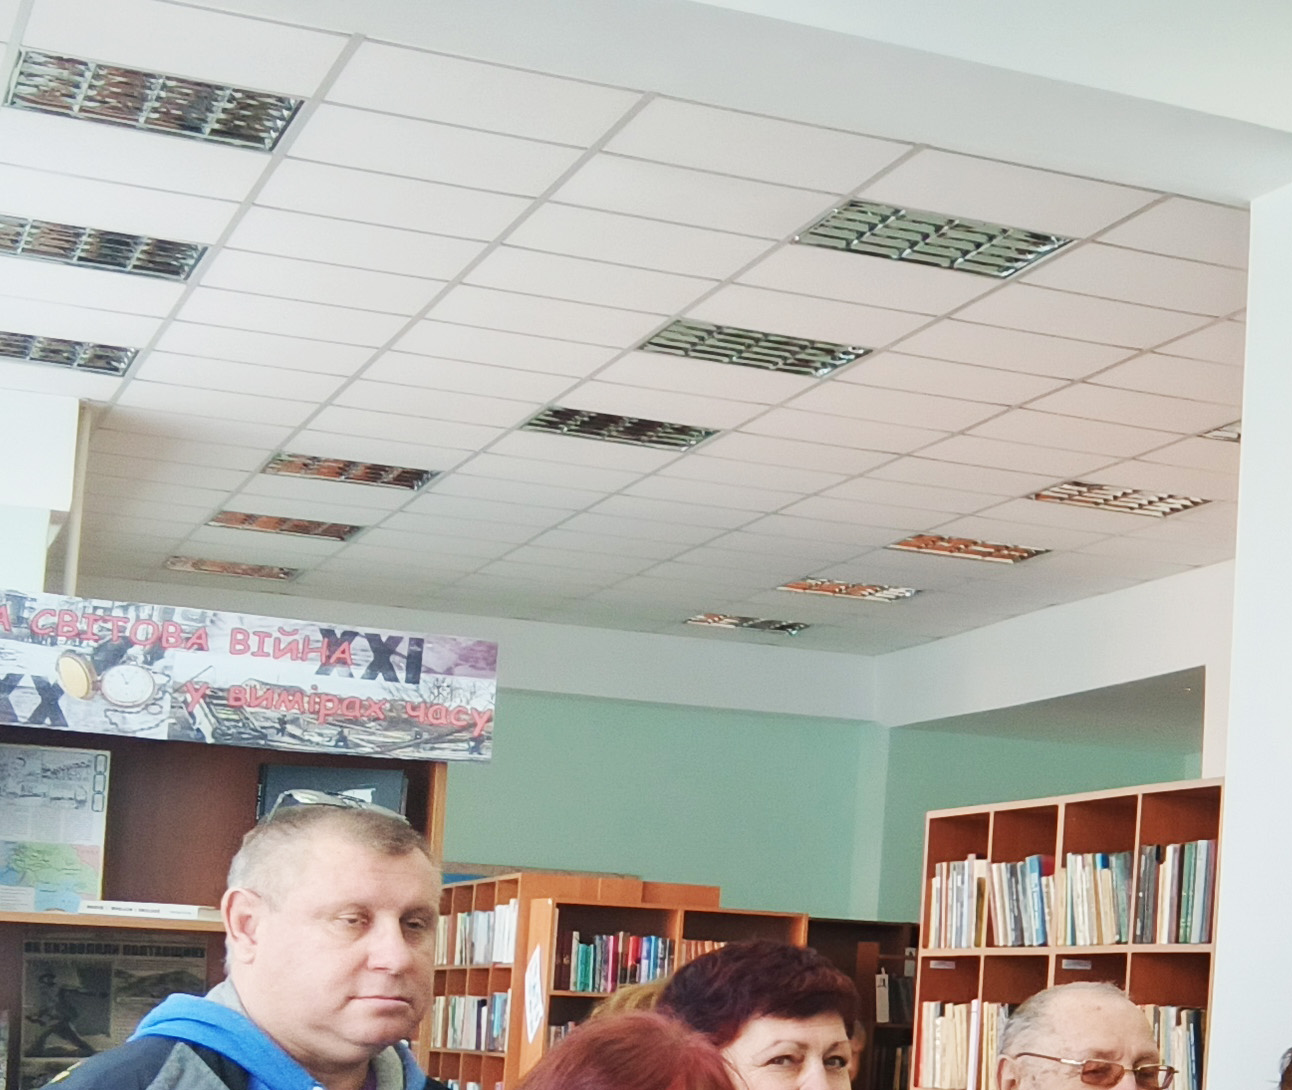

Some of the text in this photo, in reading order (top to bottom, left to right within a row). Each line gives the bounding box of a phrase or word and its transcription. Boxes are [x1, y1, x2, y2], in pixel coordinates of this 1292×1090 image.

[30, 608, 209, 651] СВІТОВА
[229, 626, 353, 667] ВІЙНА
[227, 683, 387, 725] вимірах
[404, 701, 493, 738] часу
